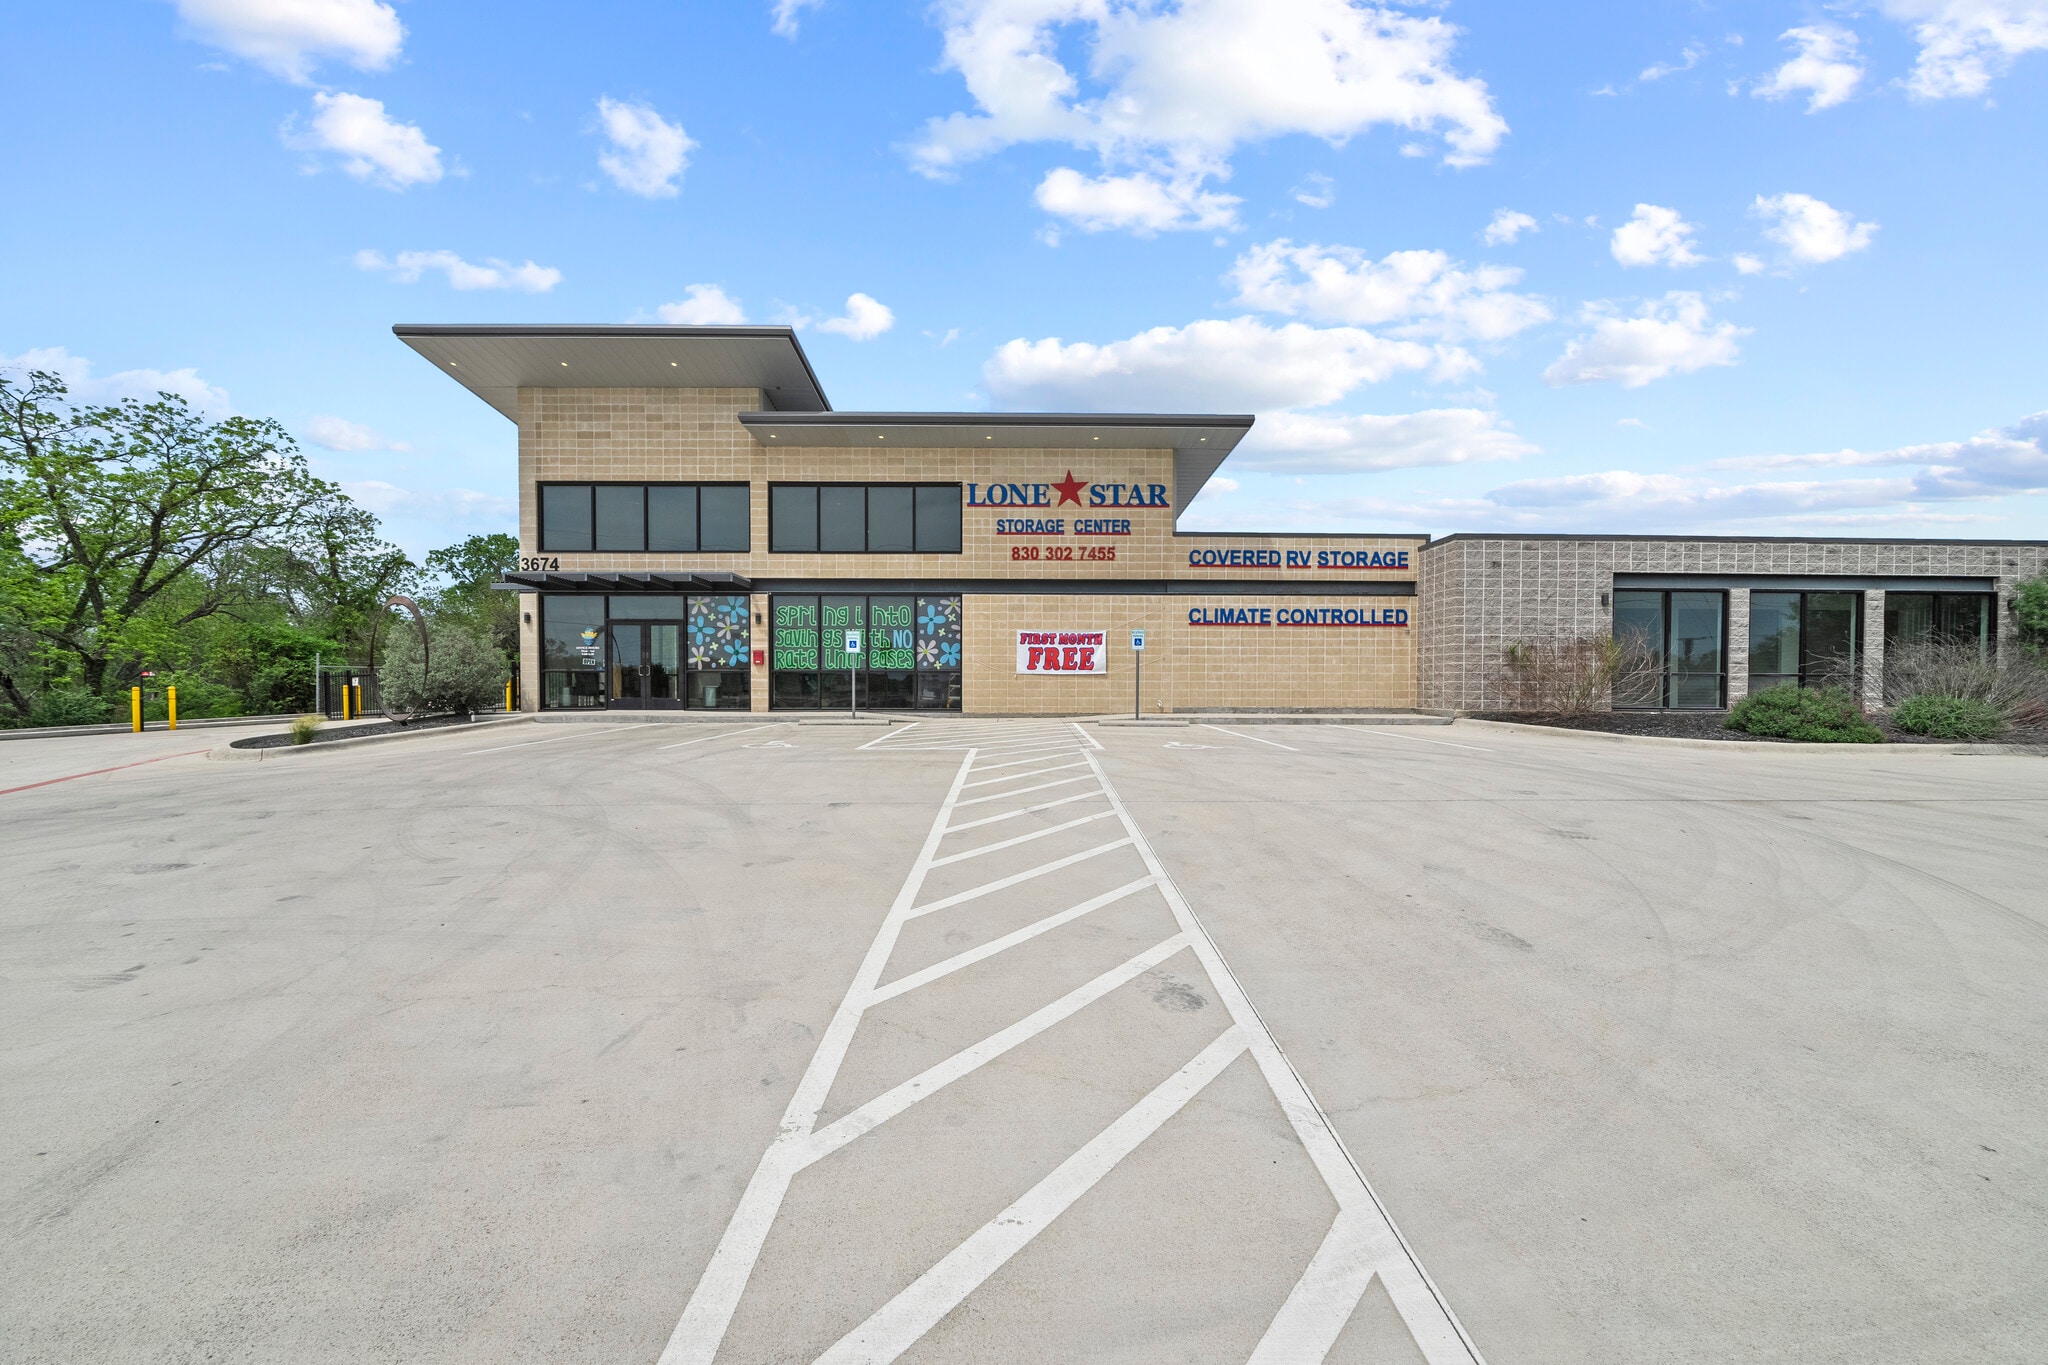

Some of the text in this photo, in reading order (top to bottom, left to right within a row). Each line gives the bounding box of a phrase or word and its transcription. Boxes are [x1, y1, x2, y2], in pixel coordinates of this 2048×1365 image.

[967, 483, 1170, 506] LONE STAR
[996, 519, 1132, 533] STORAGE CENTER
[1011, 546, 1116, 560] 830 302 7455
[1188, 549, 1409, 567] COVERED RV STORAGE
[521, 557, 560, 571] 3674
[1188, 608, 1409, 625] CLIMATE CONTROLLED
[892, 629, 913, 649] NO
[1020, 632, 1103, 645] FIRST MONTH
[1027, 647, 1094, 670] FREE
